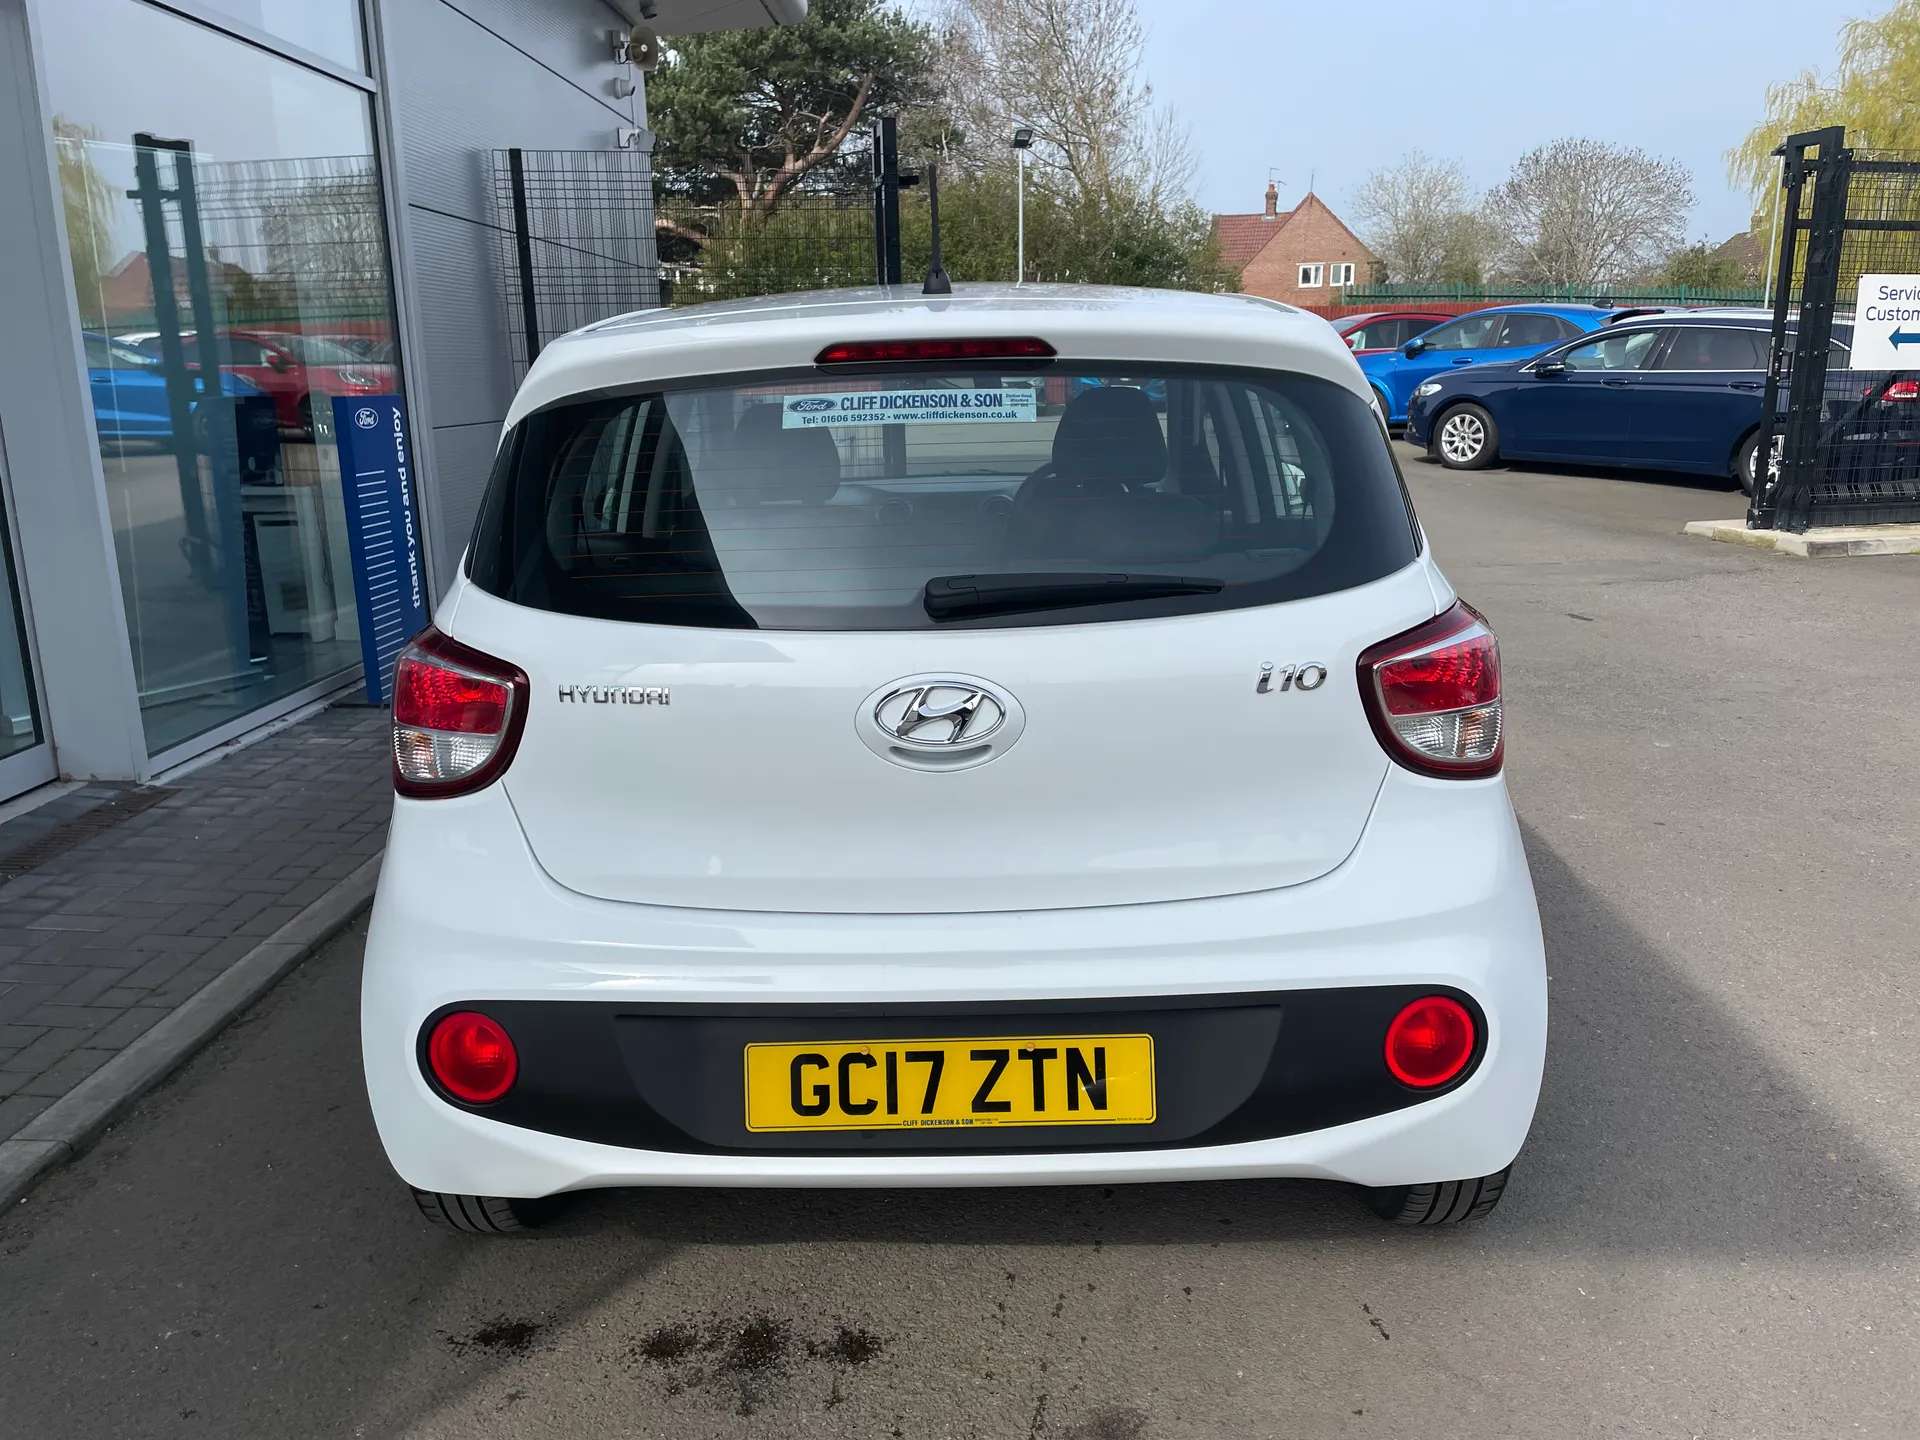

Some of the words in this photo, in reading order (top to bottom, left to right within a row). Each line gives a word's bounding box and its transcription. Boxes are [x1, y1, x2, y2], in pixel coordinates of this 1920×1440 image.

[802, 416, 819, 424] Tel:
[821, 414, 849, 423] 01606
[851, 413, 885, 422] 592352
[893, 410, 1017, 420] www.cliffdickenson.co.uk
[841, 397, 877, 411] CLIFF
[880, 395, 958, 410] DICKENSON
[961, 394, 972, 408] &
[974, 393, 1003, 408] SON
[392, 407, 404, 463] enjoy
[398, 467, 409, 503] and
[404, 506, 415, 548] you
[407, 549, 420, 608] thank
[559, 684, 670, 705] HYUNDAI
[1256, 661, 1328, 694] i10
[790, 1051, 944, 1117] GC17
[970, 1047, 1107, 1113] ZTN
